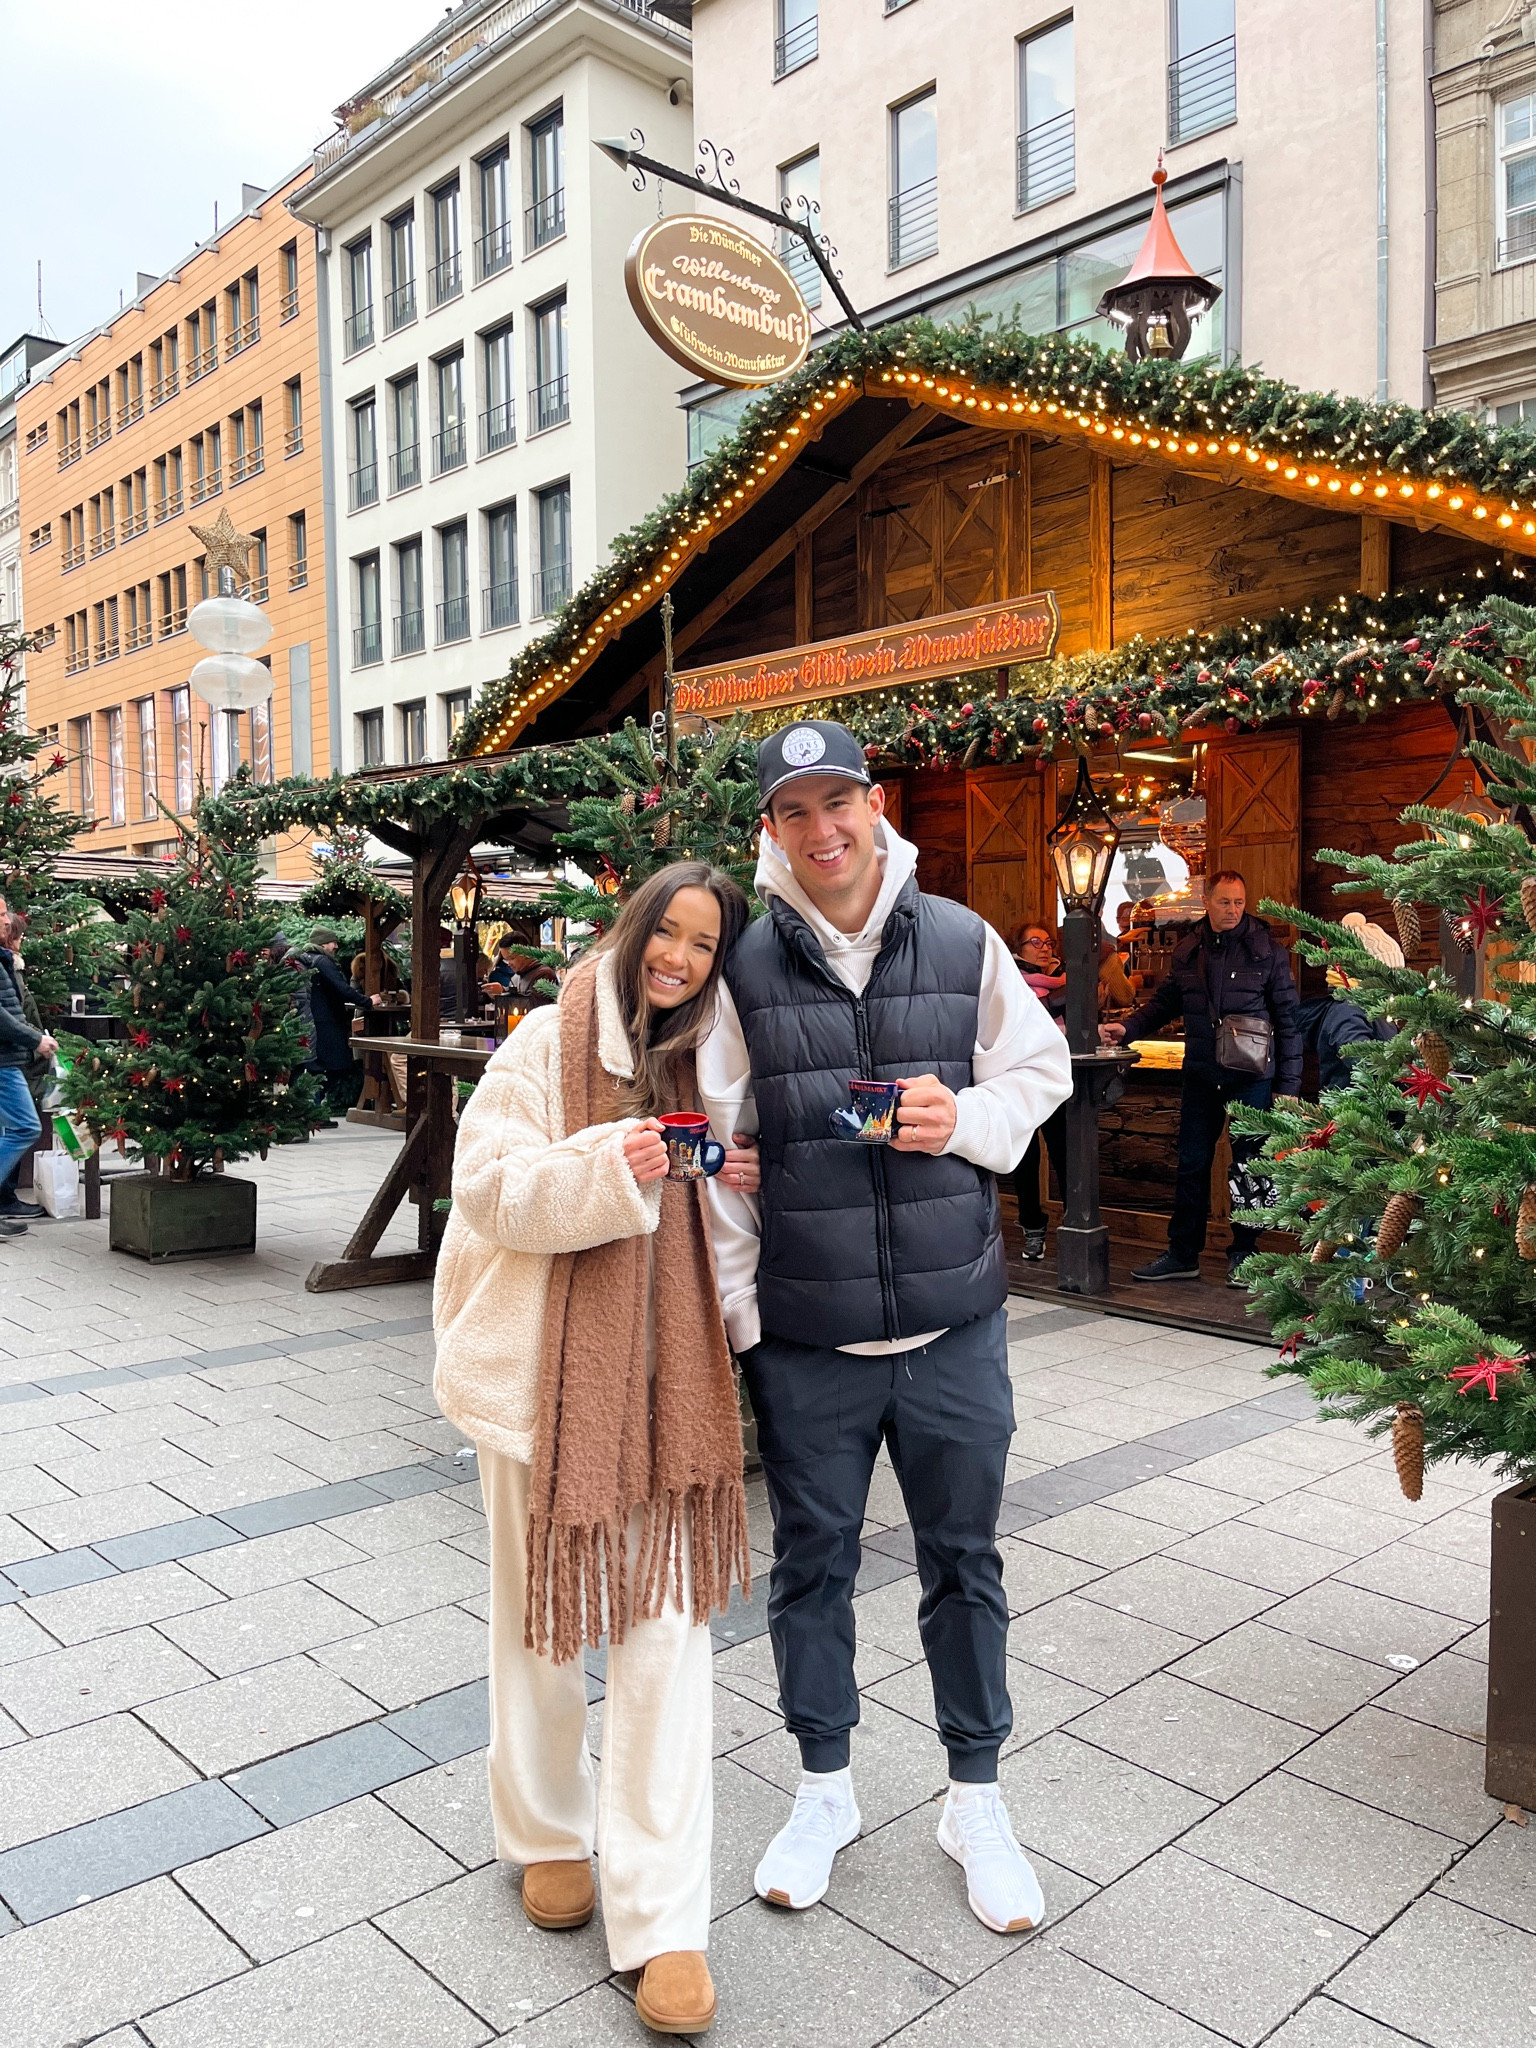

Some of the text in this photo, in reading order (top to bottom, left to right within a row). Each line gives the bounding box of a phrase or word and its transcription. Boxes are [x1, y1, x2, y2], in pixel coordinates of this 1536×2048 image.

[689, 225, 763, 268] Die Münchner
[672, 255, 782, 304] Willenborgs
[643, 263, 804, 346] Crambambuli
[674, 611, 1050, 712] Die Münchner Glühwein Manufaktur
[788, 740, 818, 754] LIONS
